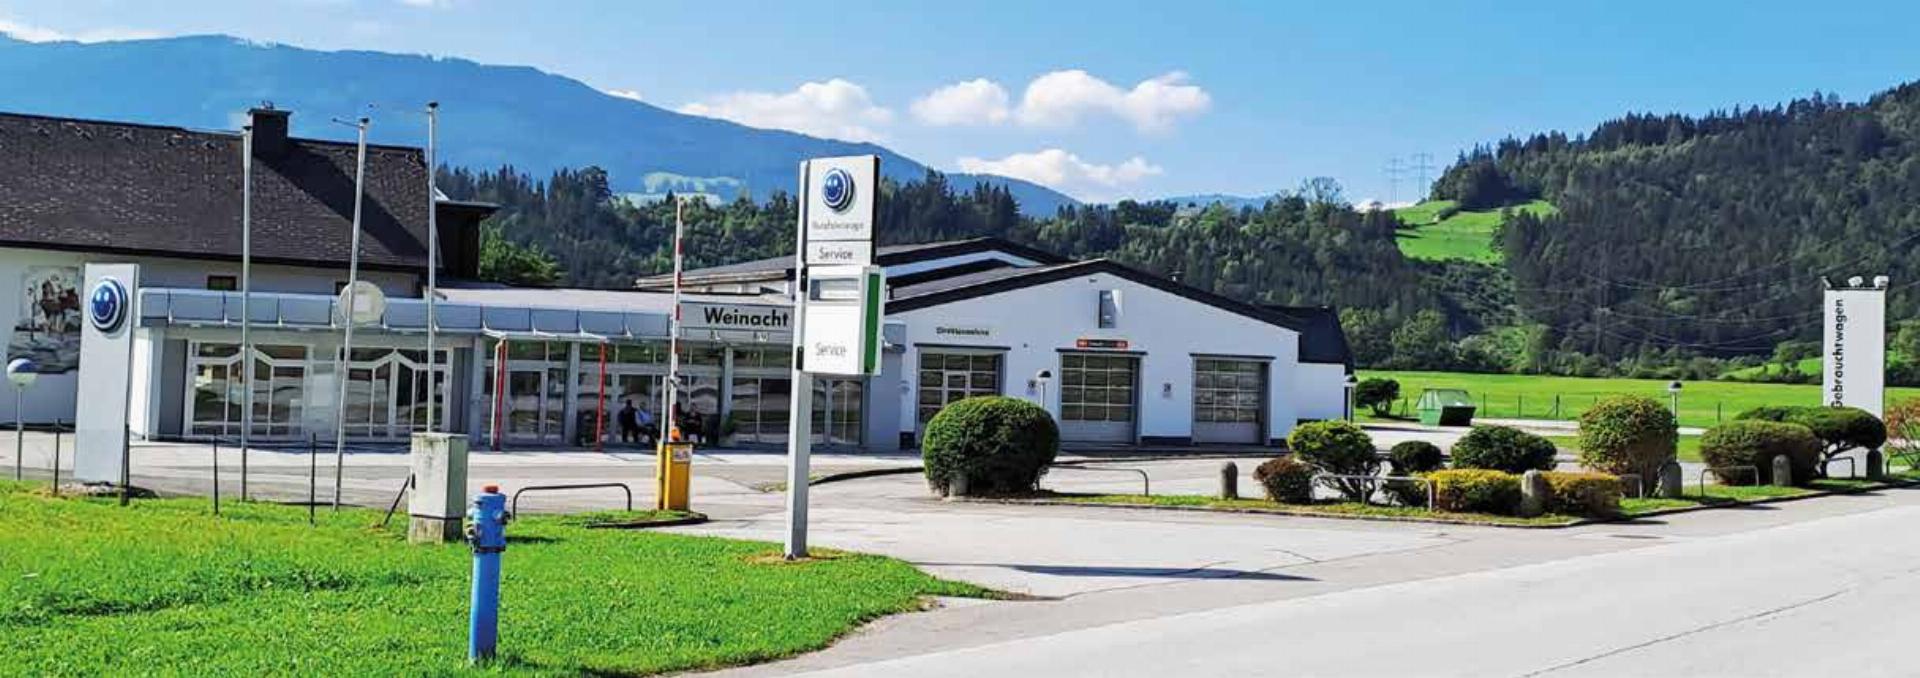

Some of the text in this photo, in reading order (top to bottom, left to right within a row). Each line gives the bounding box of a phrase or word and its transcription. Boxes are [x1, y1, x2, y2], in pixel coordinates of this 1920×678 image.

[818, 247, 853, 260] Service
[703, 306, 789, 327] Weinacht
[815, 341, 847, 357] Service
[1830, 298, 1847, 410] Gebrauchtwagen
